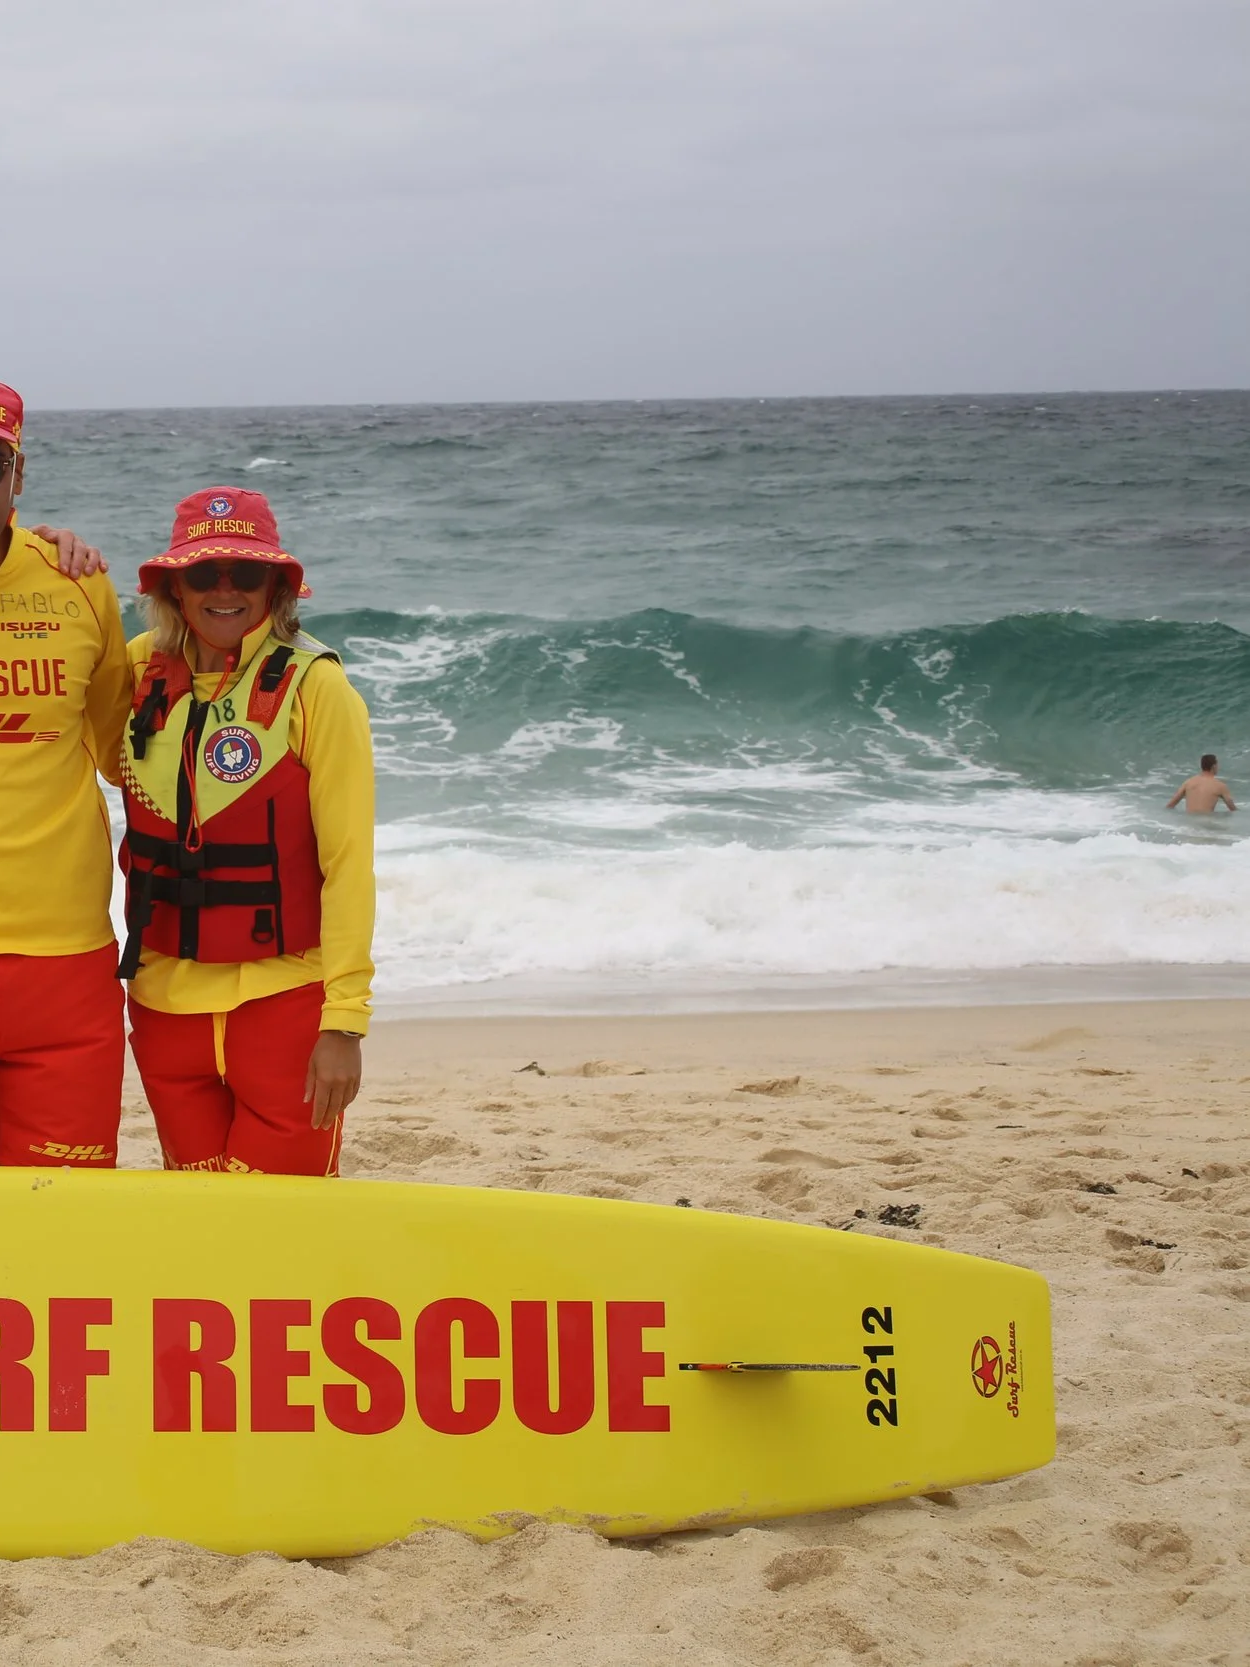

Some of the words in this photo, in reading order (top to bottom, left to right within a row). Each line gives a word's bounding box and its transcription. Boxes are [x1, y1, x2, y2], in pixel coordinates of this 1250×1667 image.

[187, 520, 212, 540] SURF
[214, 519, 257, 537] RESCUE
[0, 592, 81, 618] PABLO
[0, 621, 61, 632] ISUZU
[211, 698, 236, 723] 18
[220, 728, 252, 740] SURF
[205, 752, 221, 777] LIFE
[222, 758, 260, 782] SAVING
[41, 1141, 110, 1161] DHL
[1005, 1320, 1017, 1375] Rescue
[152, 1296, 671, 1435] RESCUE
[861, 1306, 898, 1427] 2212
[1006, 1376, 1020, 1418] Surf
